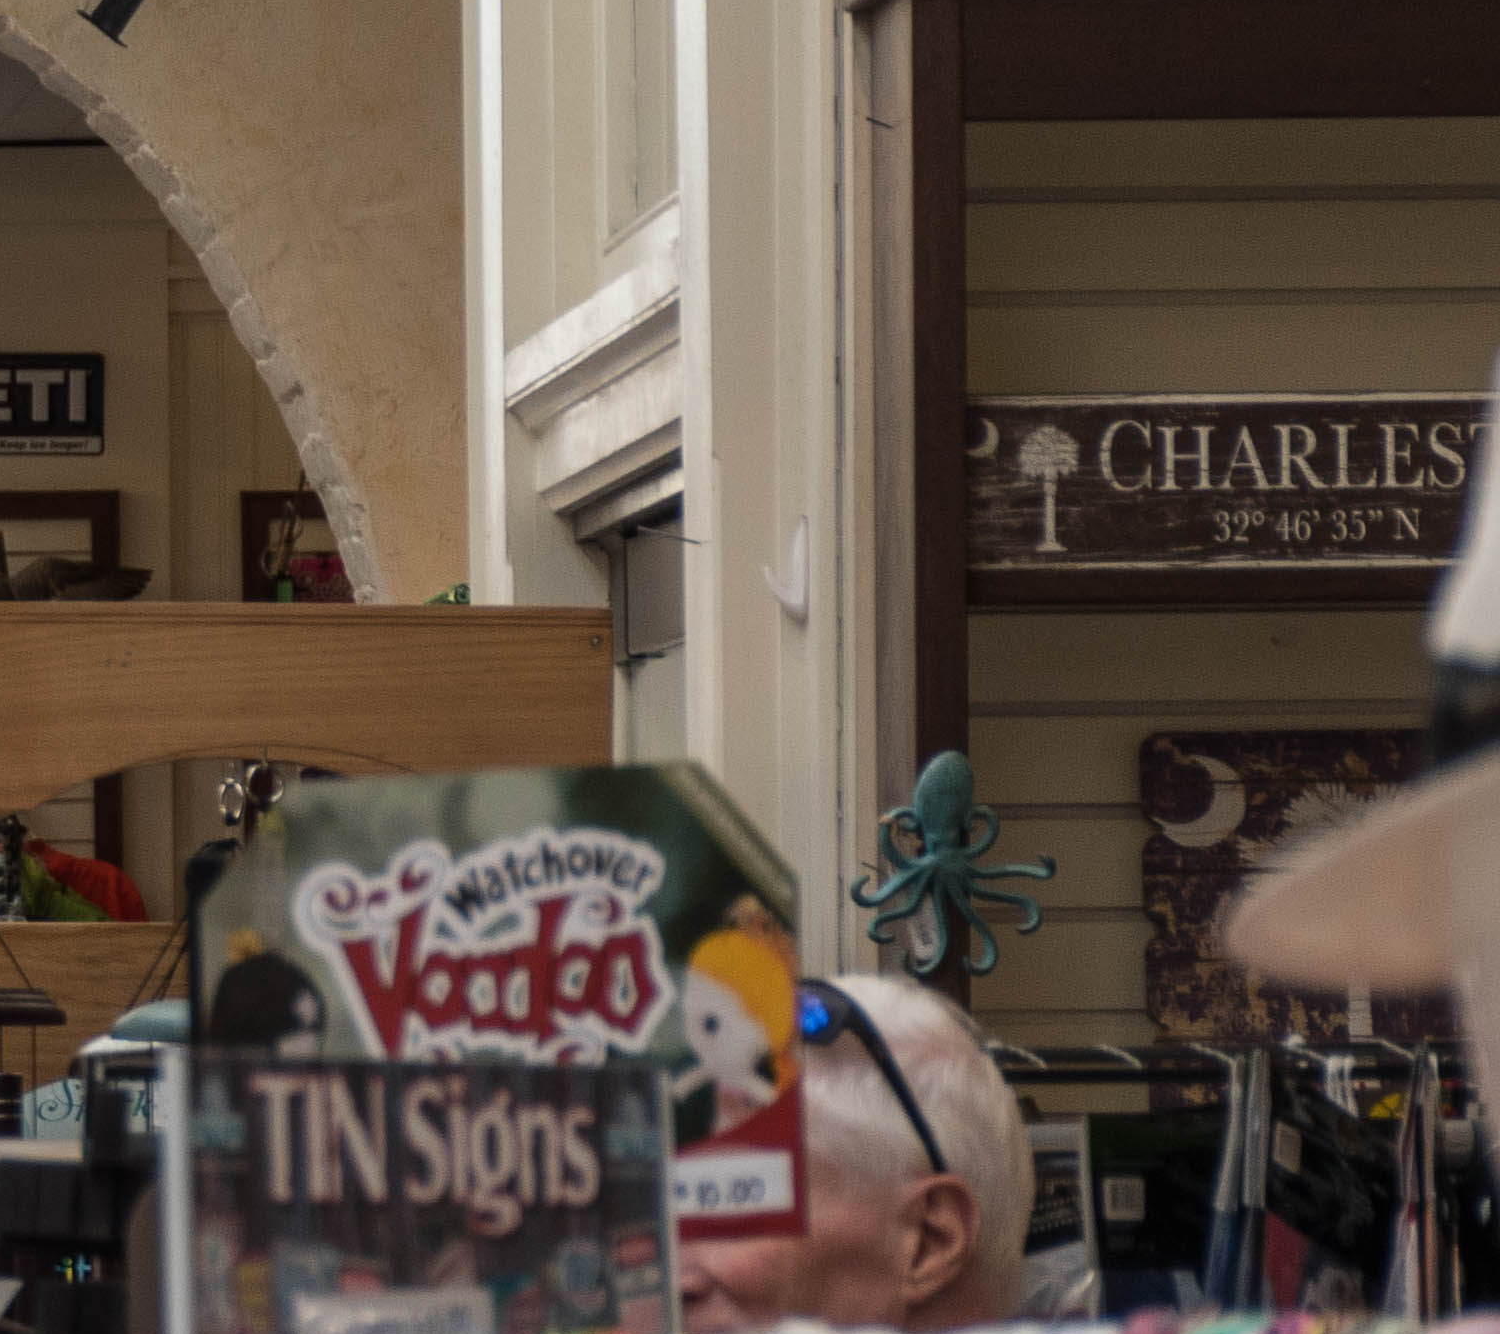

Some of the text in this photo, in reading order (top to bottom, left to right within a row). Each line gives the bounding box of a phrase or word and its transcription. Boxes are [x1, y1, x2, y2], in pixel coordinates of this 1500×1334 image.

[1100, 419, 1495, 492] CHARLES
[1393, 507, 1422, 540] N
[442, 840, 655, 923] Watchover
[338, 893, 662, 1057] Voodoo
[248, 1071, 601, 1236] TIN Signs
